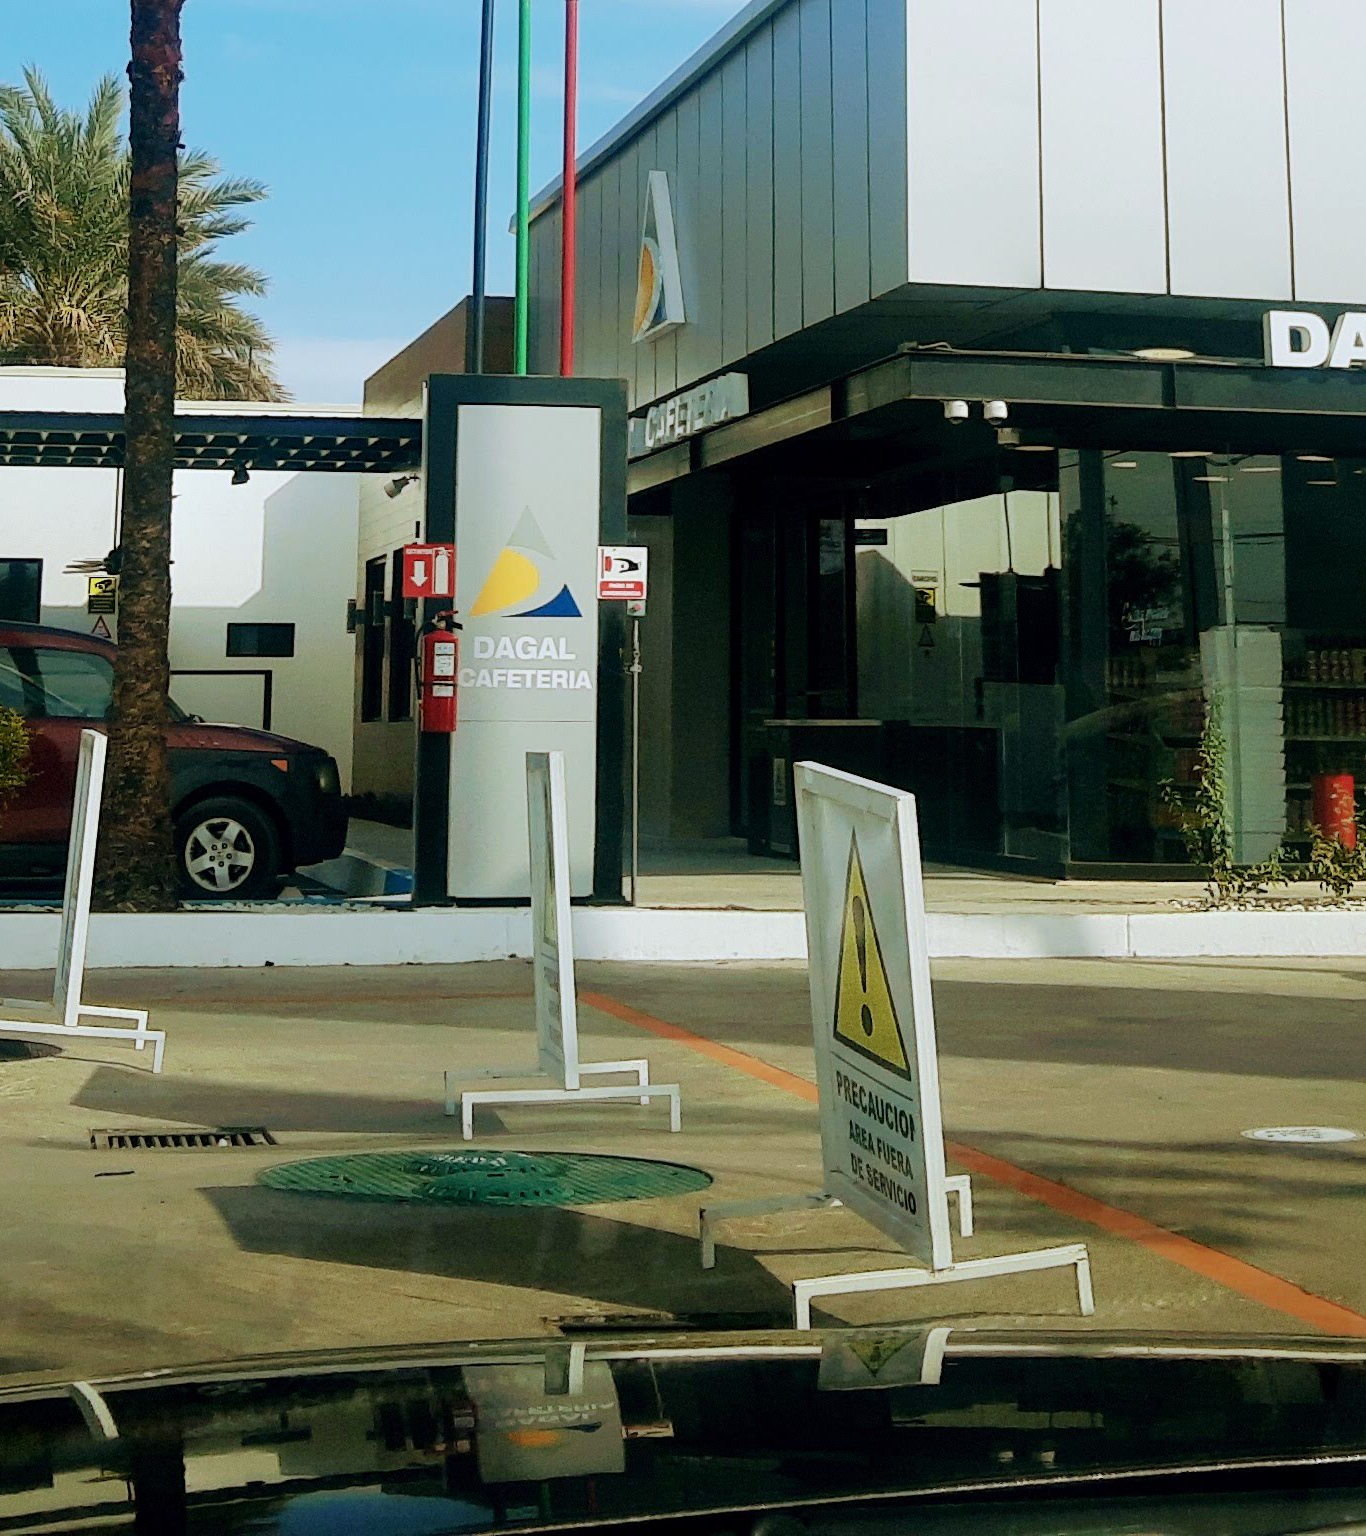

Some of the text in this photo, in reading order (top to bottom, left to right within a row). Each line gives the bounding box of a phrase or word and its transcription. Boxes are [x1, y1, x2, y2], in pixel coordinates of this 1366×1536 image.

[473, 635, 576, 660] DAGAL
[459, 667, 593, 689] CAFETERIA
[849, 1119, 914, 1181] AREA FUERA
[850, 1152, 917, 1215] DE SERVICIO
